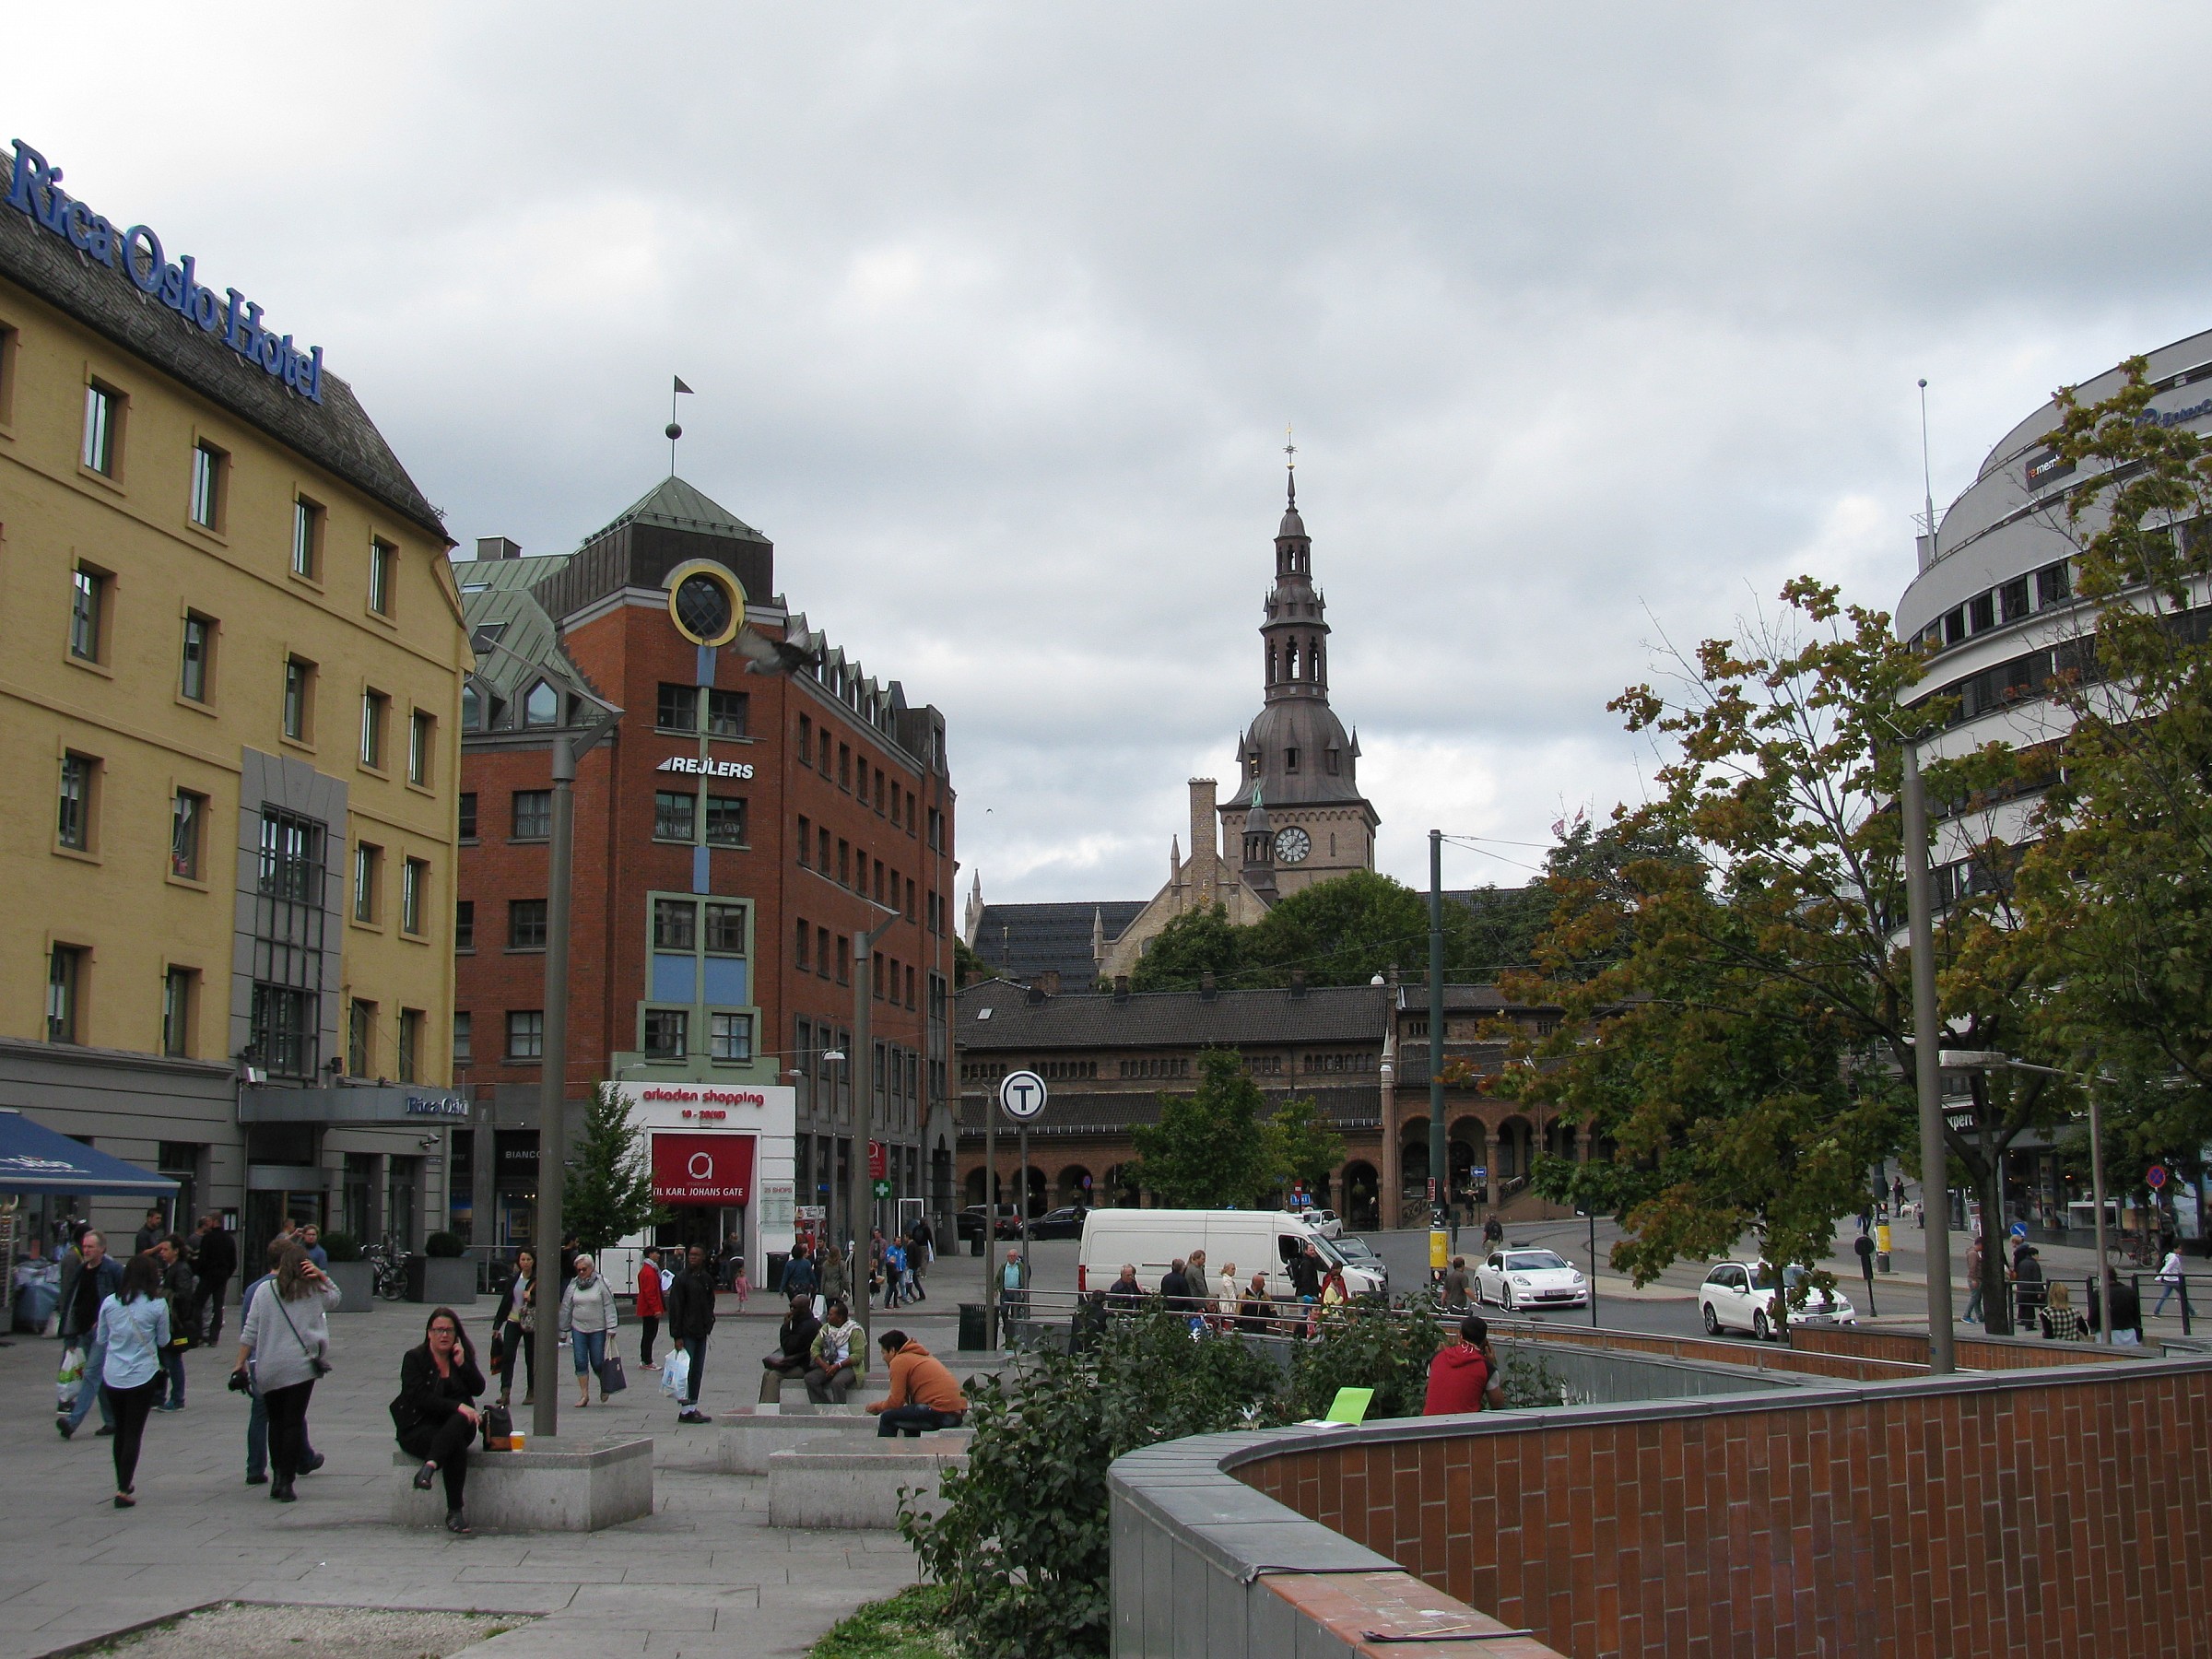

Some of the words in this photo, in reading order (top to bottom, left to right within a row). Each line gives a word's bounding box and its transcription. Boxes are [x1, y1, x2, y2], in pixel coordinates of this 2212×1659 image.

[4, 138, 114, 268] Rica
[122, 224, 219, 333] Oslo
[220, 287, 324, 405] Hotel
[406, 1097, 440, 1113] Rica
[642, 1088, 699, 1101] arkaden
[702, 1089, 764, 1107] shopping
[1012, 1085, 1034, 1112] T
[665, 1187, 687, 1197] KARL
[689, 1187, 721, 1197] JOHANS
[723, 1187, 744, 1197] GATE
